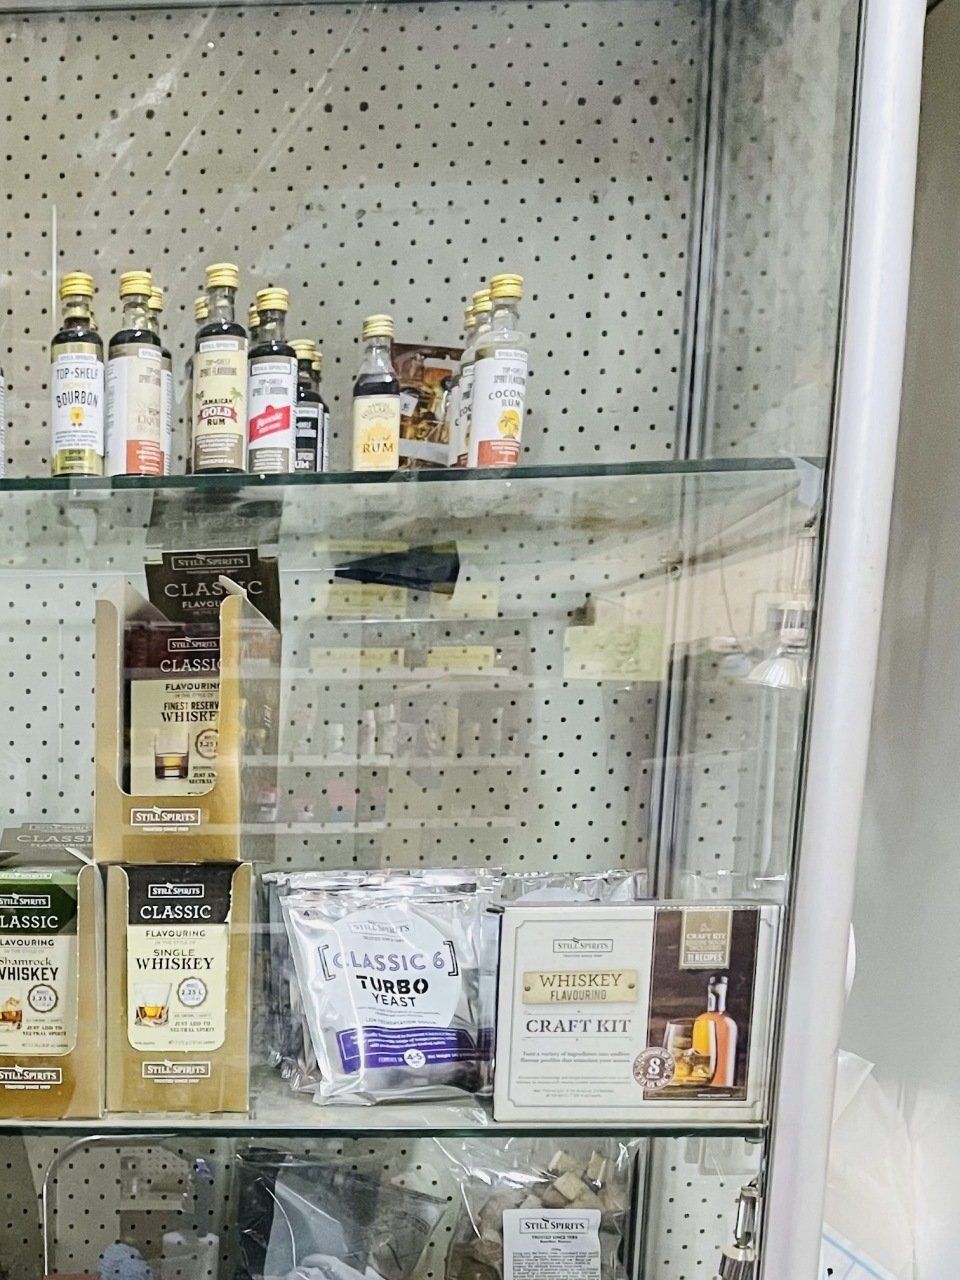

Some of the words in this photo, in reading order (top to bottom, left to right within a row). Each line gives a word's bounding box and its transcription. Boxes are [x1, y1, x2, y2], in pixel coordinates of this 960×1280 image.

[56, 390, 98, 408] BOURBON
[489, 390, 526, 400] COCON
[502, 397, 521, 407] RUM
[202, 407, 232, 417] GOLD
[207, 418, 225, 426] RUM
[362, 443, 394, 453] RUM
[177, 557, 204, 567] STILL
[206, 556, 245, 566] SPIRITS
[171, 640, 190, 648] STILL
[163, 702, 188, 711] FINEST
[191, 701, 219, 710] RESERV
[136, 811, 160, 822] STILL
[162, 811, 196, 822] SPIRITS
[152, 886, 172, 895] STILL
[173, 886, 201, 896] SPIRITS
[0, 897, 18, 905] STILL
[19, 897, 48, 905] SPIRITS
[140, 905, 212, 919] CLASSIC
[146, 929, 206, 938] FLAVOURING
[557, 940, 579, 950] STILL
[580, 942, 609, 950] SPIRITS
[153, 949, 195, 957] SINGLE
[136, 957, 214, 970] WHISKEY
[356, 974, 429, 995] TURBO
[539, 973, 622, 988] WHISKEY
[372, 993, 416, 1008] YEAST
[550, 990, 607, 1001] FLAVOURING
[526, 1019, 592, 1033] CRAFT
[597, 1019, 631, 1033] KIT
[147, 1064, 171, 1075] STILL
[172, 1064, 206, 1075] SPIRITS
[24, 1072, 57, 1081] SPIRITS
[551, 1222, 584, 1230] SPIRITS
